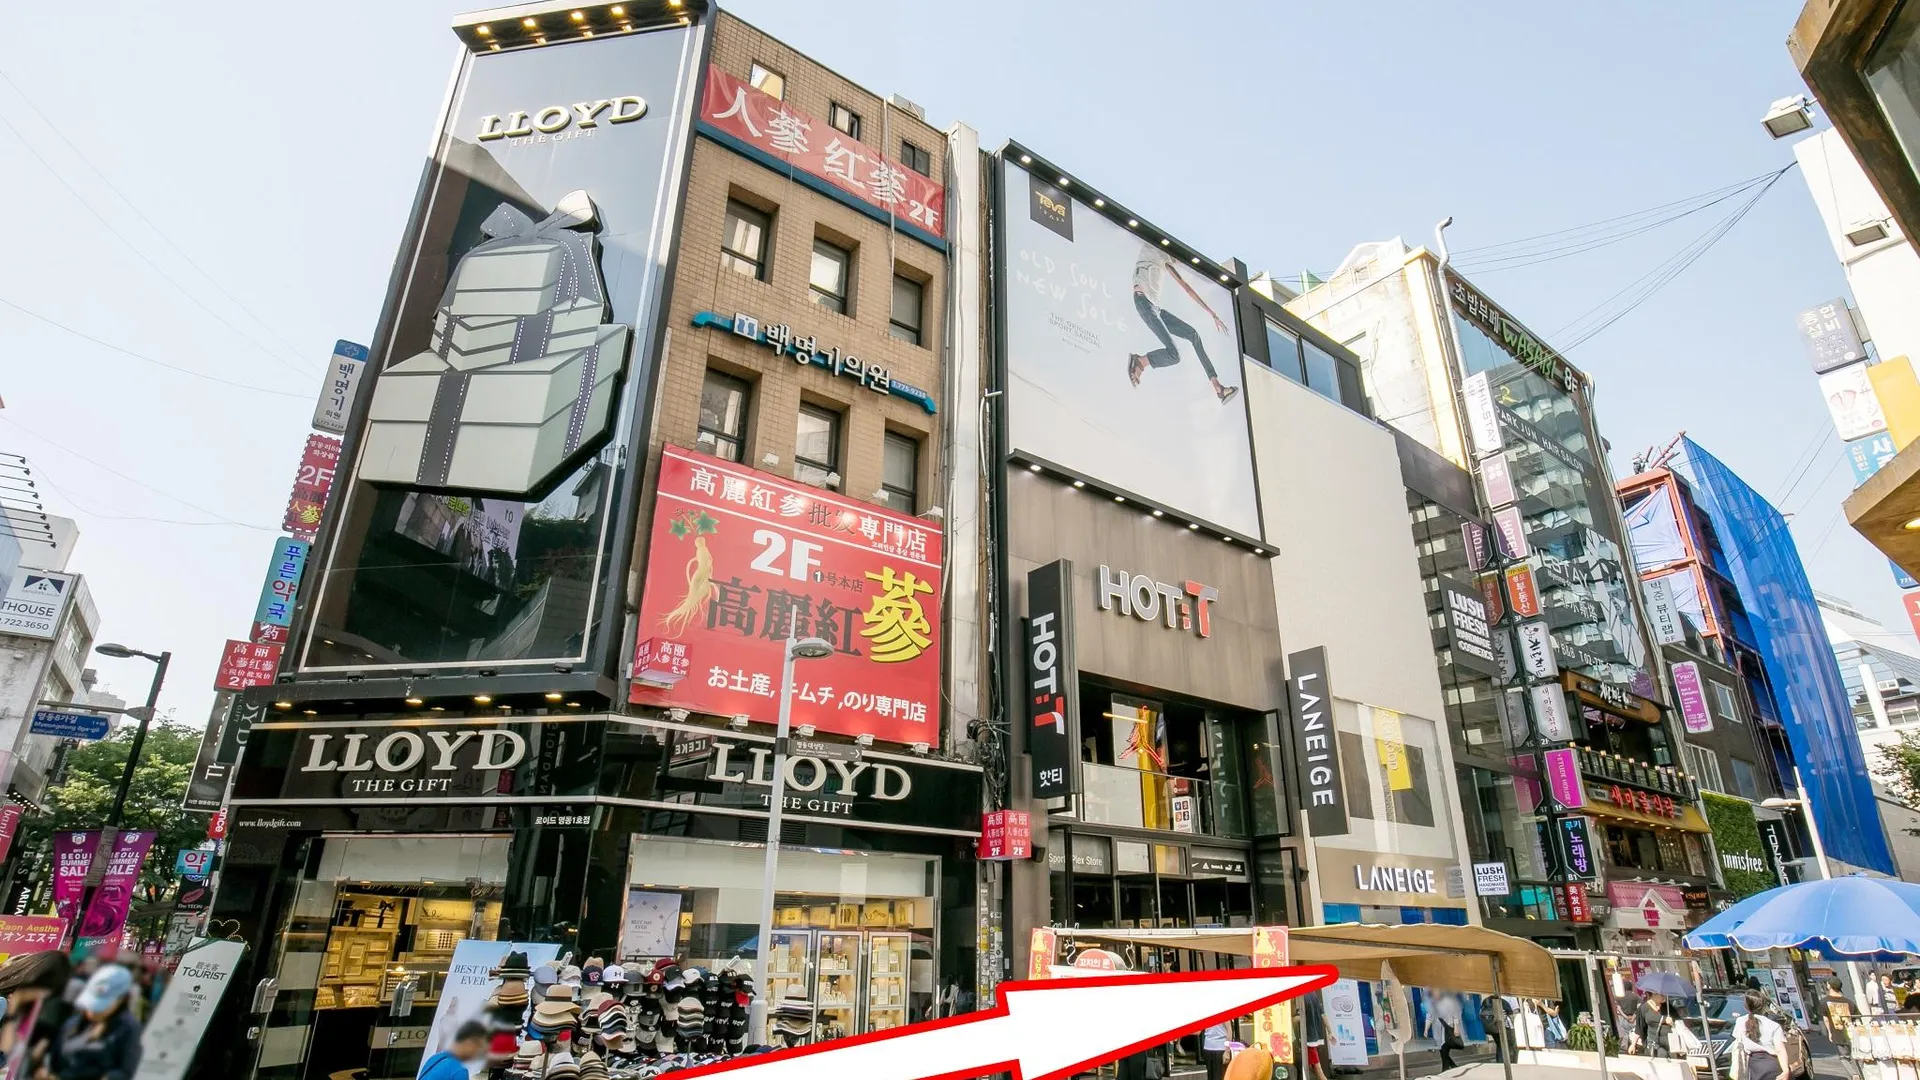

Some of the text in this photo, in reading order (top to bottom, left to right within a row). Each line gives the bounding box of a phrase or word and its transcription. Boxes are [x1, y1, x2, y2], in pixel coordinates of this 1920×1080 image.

[477, 96, 648, 142] LLOYD
[510, 128, 597, 148] THE GIFT
[909, 199, 938, 228] 2F
[1035, 191, 1066, 217] Teva
[764, 323, 892, 396] 백명기의원
[330, 363, 355, 411] 백명기
[1563, 366, 1578, 394] 8F
[299, 465, 334, 487] 2F
[750, 529, 825, 582] 2F
[268, 545, 302, 620] 푸른약국
[1448, 589, 1486, 621] LUSH
[1452, 609, 1490, 639] FRESH
[301, 729, 527, 773] LLOYD
[1297, 672, 1335, 807] LANEIGE
[707, 742, 913, 801] LLOYD
[1039, 766, 1064, 787] 핫티
[352, 777, 452, 793] THE GIFT
[807, 798, 853, 815] GIFT
[239, 817, 302, 830] www.lloydgift.com
[535, 816, 557, 825] 로이드
[1013, 846, 1024, 856] 2F
[1085, 856, 1103, 867] Store
[1722, 849, 1763, 875] innisfree
[184, 852, 208, 875] 약
[1476, 866, 1504, 875] LUSH
[1354, 864, 1437, 894] LANEIGE
[1478, 874, 1505, 882] FRESH
[182, 966, 228, 981] TOURIST
[454, 964, 481, 975] BEST
[460, 975, 486, 986] EVER
